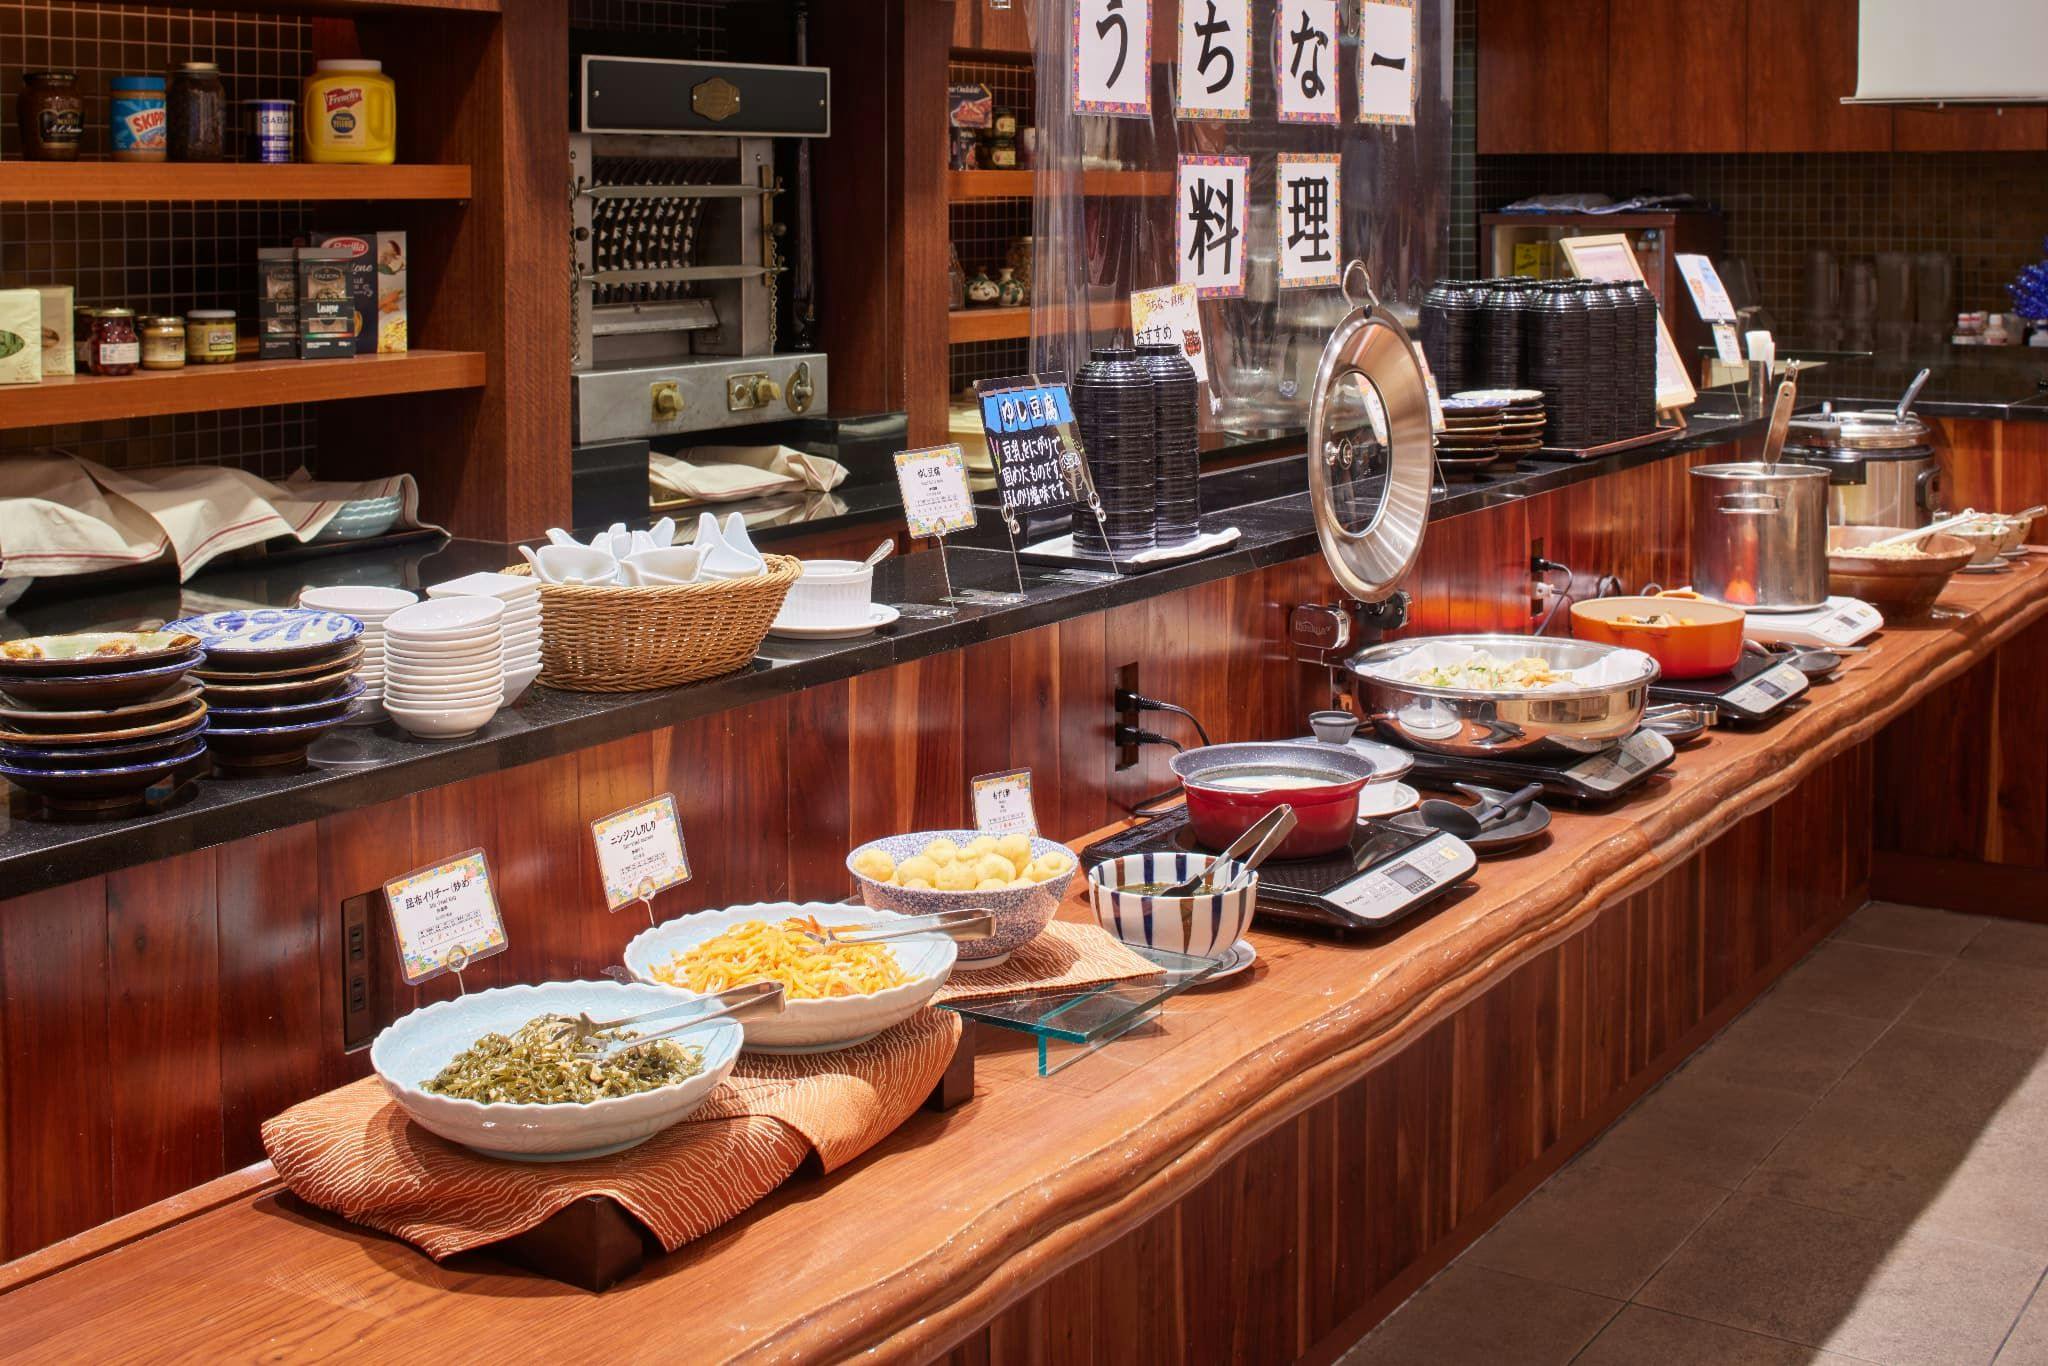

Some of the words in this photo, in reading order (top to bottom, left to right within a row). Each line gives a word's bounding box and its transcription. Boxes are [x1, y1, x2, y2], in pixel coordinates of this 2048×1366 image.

[132, 111, 165, 133] SKIPP
[1188, 176, 1332, 275] 料理
[1136, 324, 1172, 345] おすすめ
[1001, 392, 1058, 428] ゆし豆腐
[1002, 435, 1061, 464] 豆乳をにがりで
